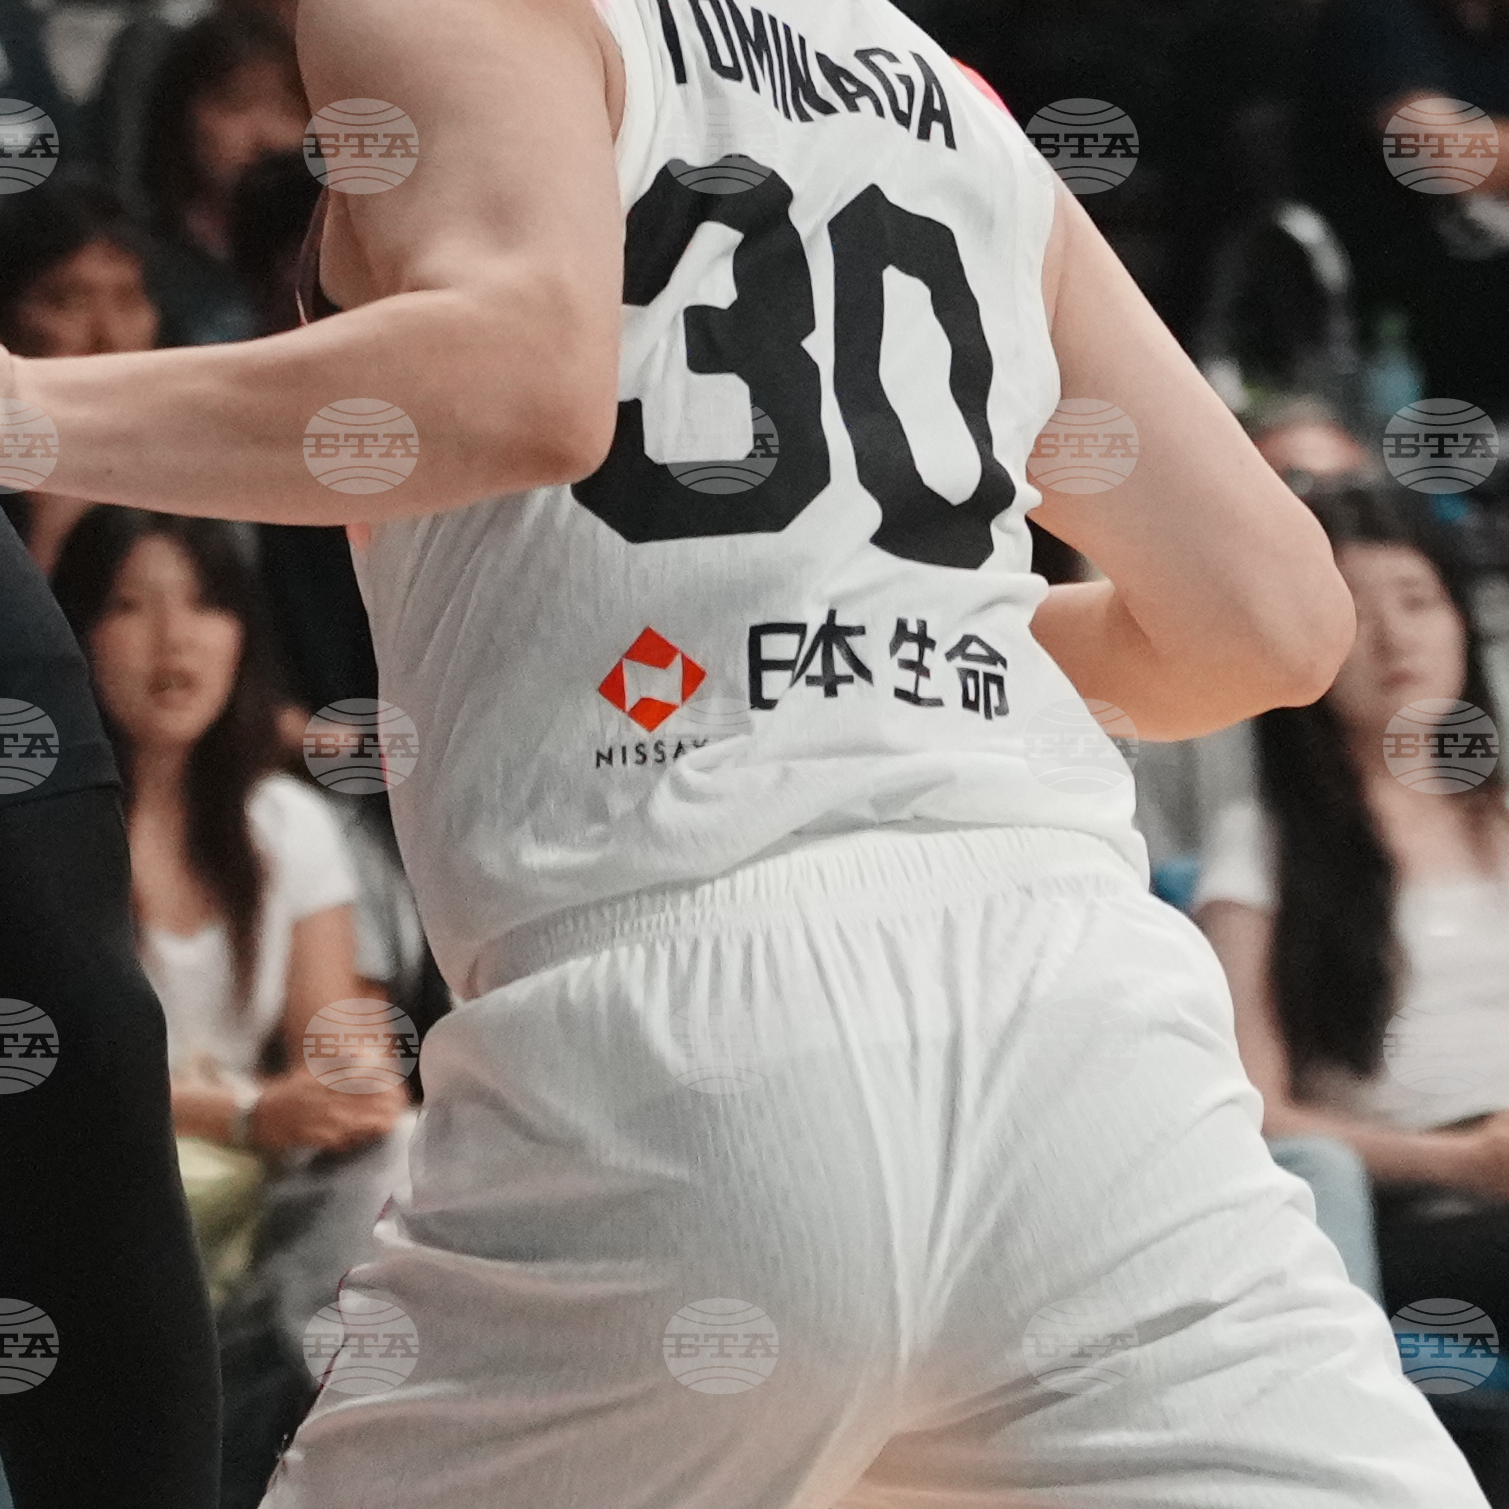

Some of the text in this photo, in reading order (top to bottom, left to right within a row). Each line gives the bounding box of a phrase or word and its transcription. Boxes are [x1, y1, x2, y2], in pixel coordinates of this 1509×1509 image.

[572, 154, 1016, 569] 30
[748, 609, 1010, 721] 日本生命
